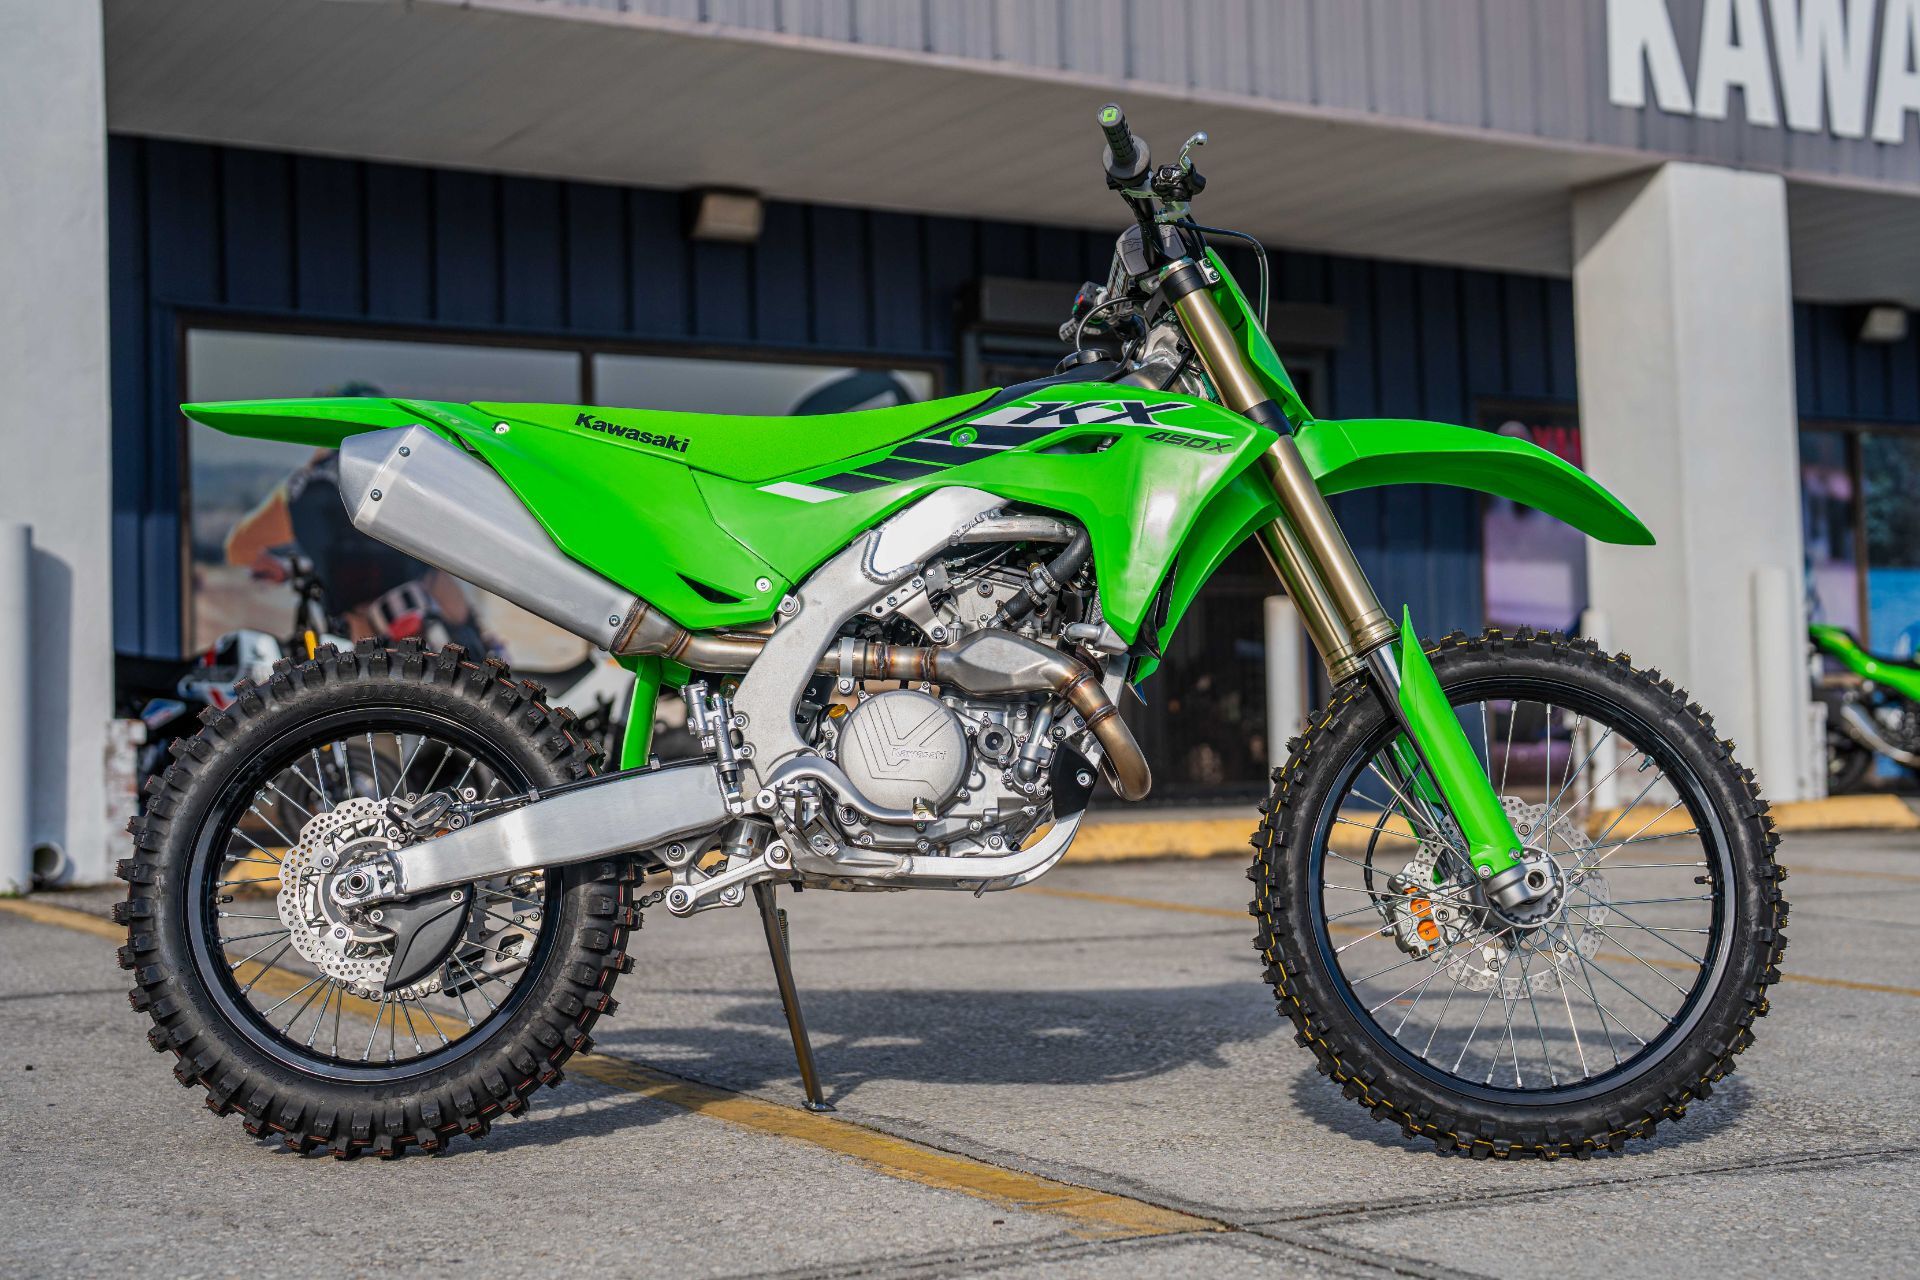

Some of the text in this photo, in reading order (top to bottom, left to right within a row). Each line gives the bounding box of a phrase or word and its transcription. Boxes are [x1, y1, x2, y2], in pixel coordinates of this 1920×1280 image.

[1006, 401, 1191, 425] KX
[575, 412, 690, 453] Kawasaki
[891, 747, 947, 760] Kawasaki
